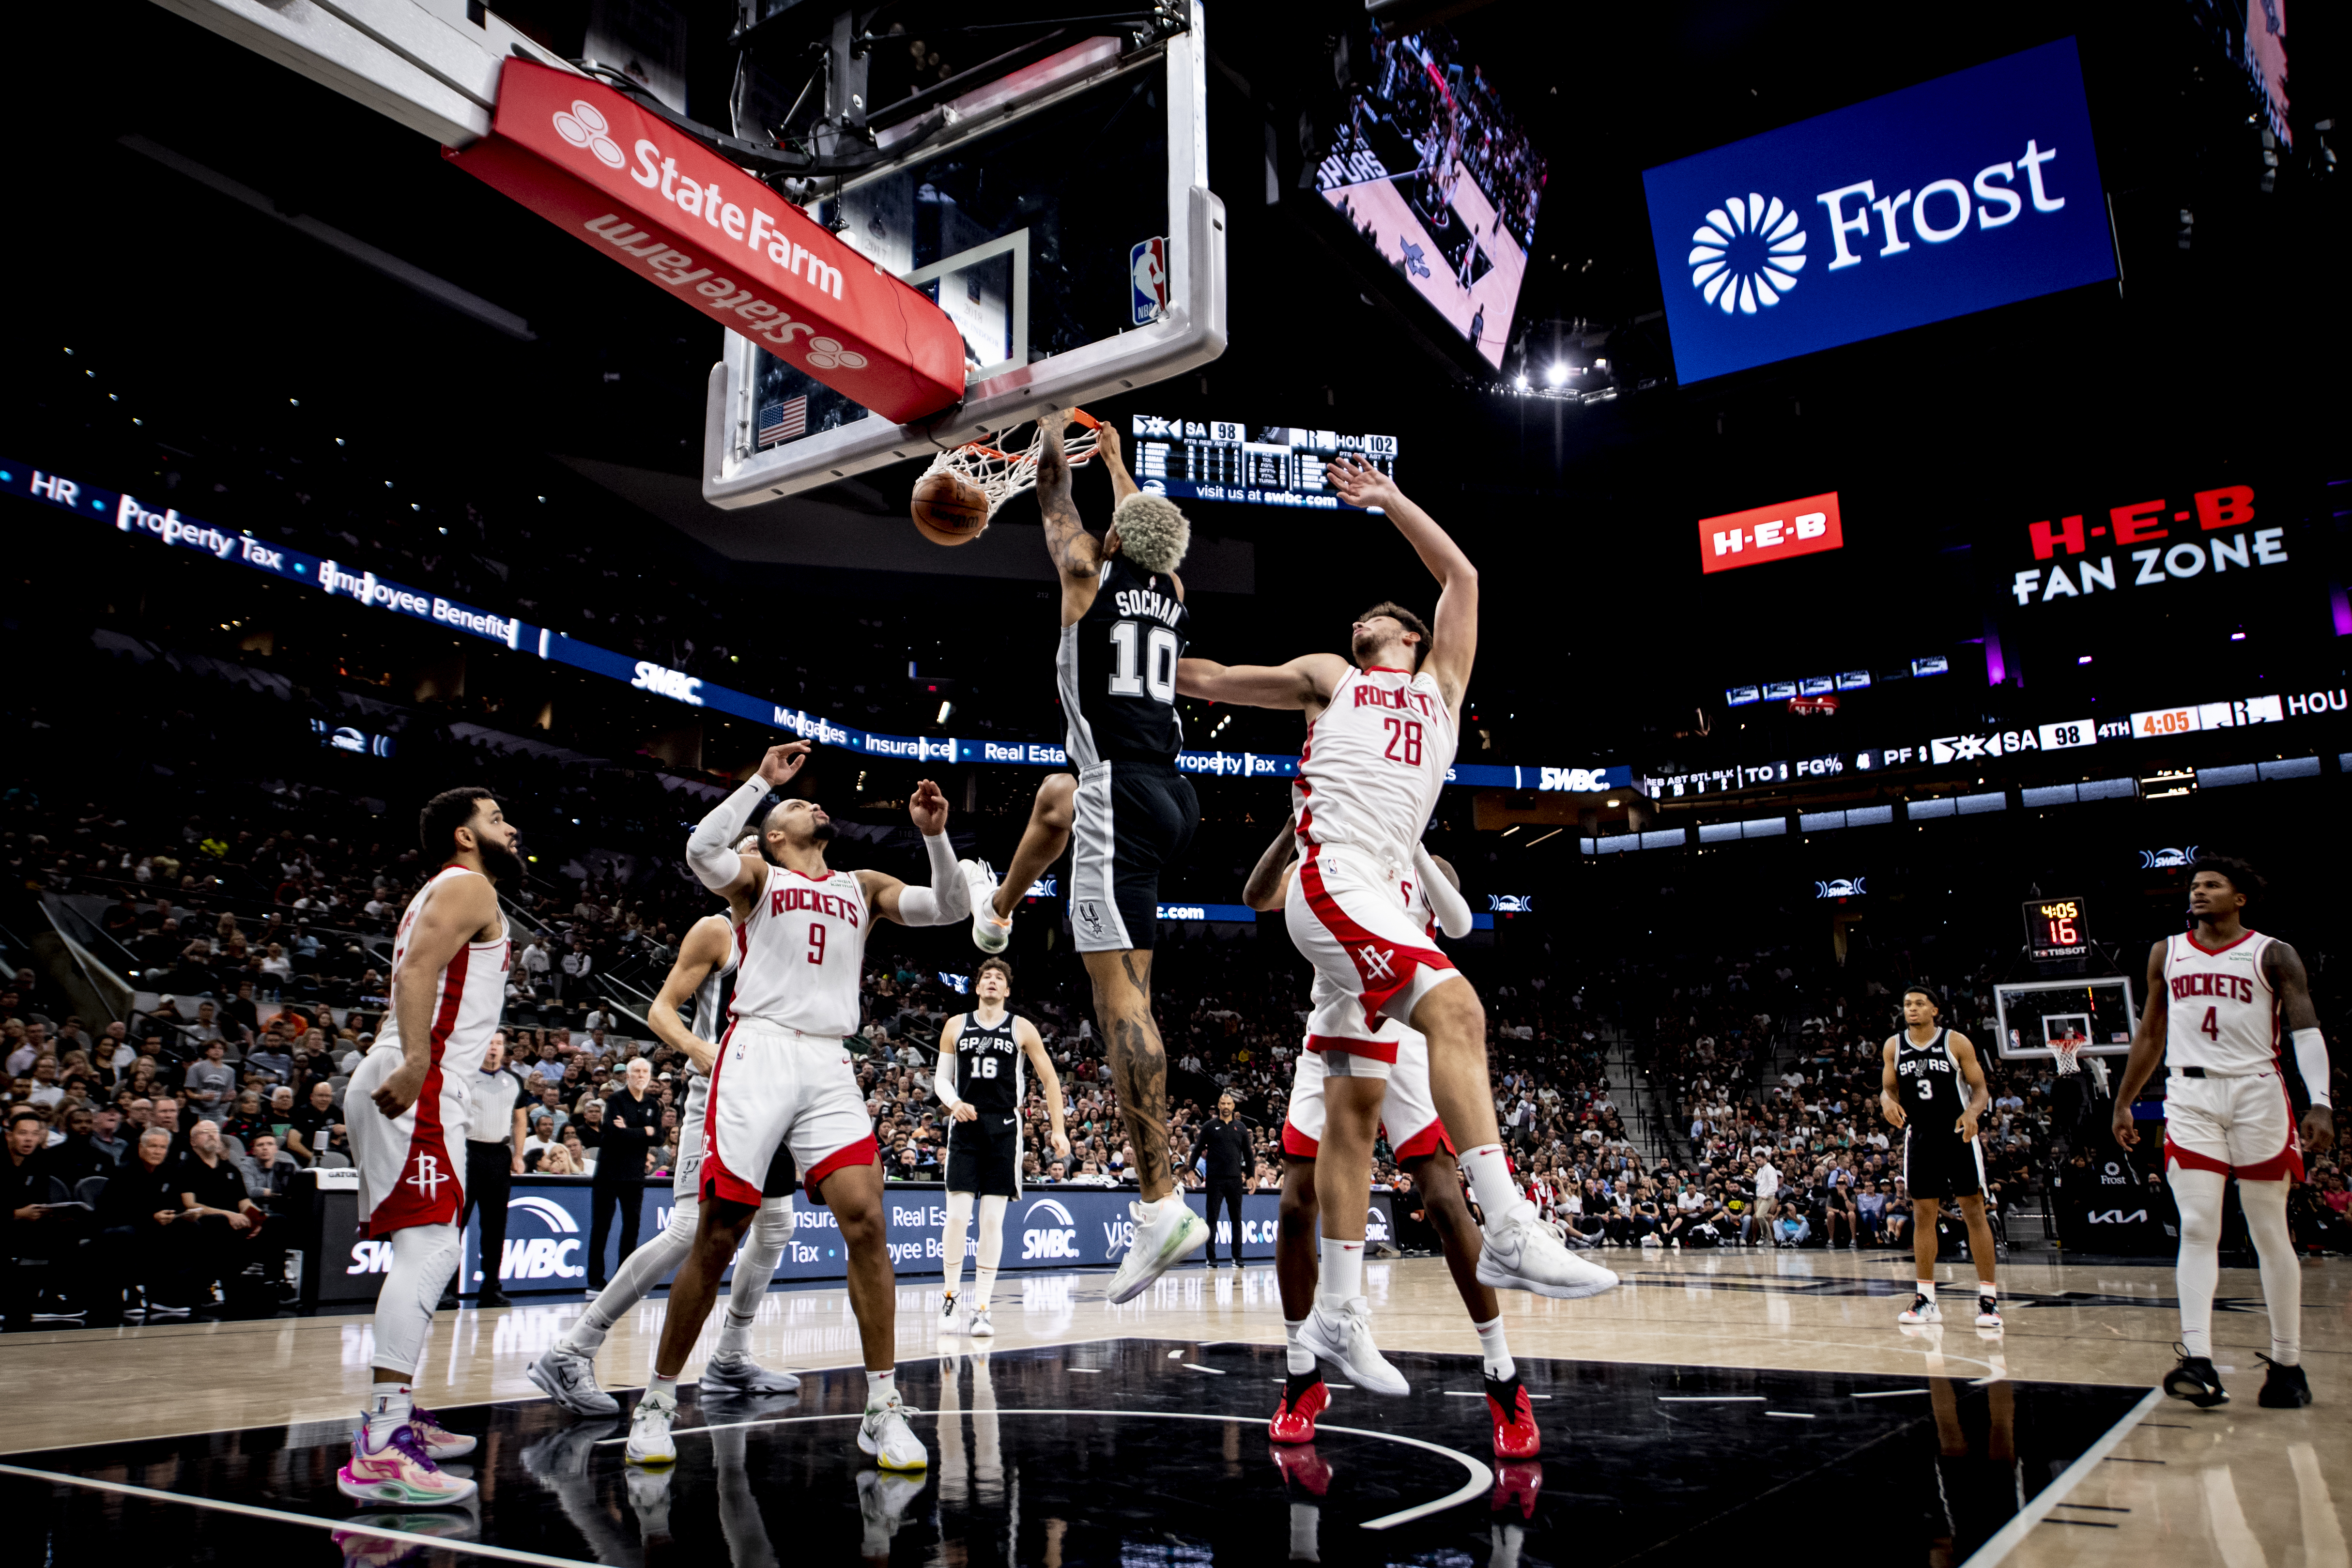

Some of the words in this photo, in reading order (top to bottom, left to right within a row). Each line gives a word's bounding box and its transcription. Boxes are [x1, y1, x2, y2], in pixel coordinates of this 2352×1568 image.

[1816, 138, 2065, 272] Frost
[964, 303, 983, 323] 2018
[1138, 302, 1156, 320] NBA
[970, 323, 999, 348] INDOOR
[1185, 422, 1207, 436] SA
[1218, 423, 1236, 440] 98
[1335, 435, 1365, 449] HOU
[1369, 436, 1393, 452] 102
[1196, 484, 1224, 498] visit
[1227, 489, 1244, 499] us
[1247, 489, 1261, 501] at
[1264, 490, 1337, 507] swbc.com
[930, 507, 979, 528] Wilson
[31, 470, 80, 508] HR
[116, 493, 236, 559] Property
[239, 535, 284, 570] Tax
[318, 559, 430, 614] Empoyee
[432, 597, 516, 643] Benefits
[2013, 556, 2116, 606] FAN
[2132, 527, 2289, 586] ZONE
[1115, 589, 1182, 628] SOCHAN
[1108, 619, 1178, 706] 10
[1354, 685, 1437, 727] ROCKETS
[2004, 729, 2039, 753] SA
[2055, 726, 2080, 745] 98
[2098, 721, 2130, 739] 4TH
[2143, 711, 2190, 735] 4:05
[2288, 689, 2348, 716] HOU
[774, 706, 847, 745] Mortgages
[865, 734, 953, 760] Insurance
[985, 743, 1025, 762] Real
[1029, 745, 1066, 764] Esta
[1246, 755, 1276, 773] Tax
[1384, 717, 1422, 766] 28
[1646, 778, 1665, 787] REB
[1667, 775, 1689, 786] AST
[1691, 772, 1711, 784] STL
[1712, 769, 1734, 781] BLK
[1745, 766, 1773, 783] TO
[1797, 757, 1843, 776] FG%
[1884, 748, 1912, 766] PF
[1721, 778, 1727, 791] 2
[2154, 856, 2186, 868] SWBC
[1827, 886, 1855, 898] SWBC
[771, 888, 858, 928] ROCKETS
[1156, 907, 1204, 920] c.com
[1498, 902, 1522, 912] SWBC
[2042, 902, 2078, 918] 4:05
[808, 922, 826, 965] 9
[2050, 918, 2076, 944] 16
[2048, 946, 2087, 956] TISSOT
[2170, 973, 2253, 1004] ROCKETS
[2201, 1006, 2219, 1041] 4
[970, 1056, 998, 1079] 16
[1917, 1079, 1933, 1100] 3
[2101, 1175, 2126, 1184] Frost
[794, 1211, 838, 1228] nsura
[892, 1206, 926, 1227] Real
[1104, 1214, 1134, 1247] vis
[1366, 1223, 1388, 1241] SWBC
[788, 1241, 819, 1263] Tax
[886, 1242, 922, 1264] oyee
[1022, 1229, 1079, 1258] SWBC
[347, 1241, 394, 1275] SW
[499, 1238, 582, 1280] WBC
